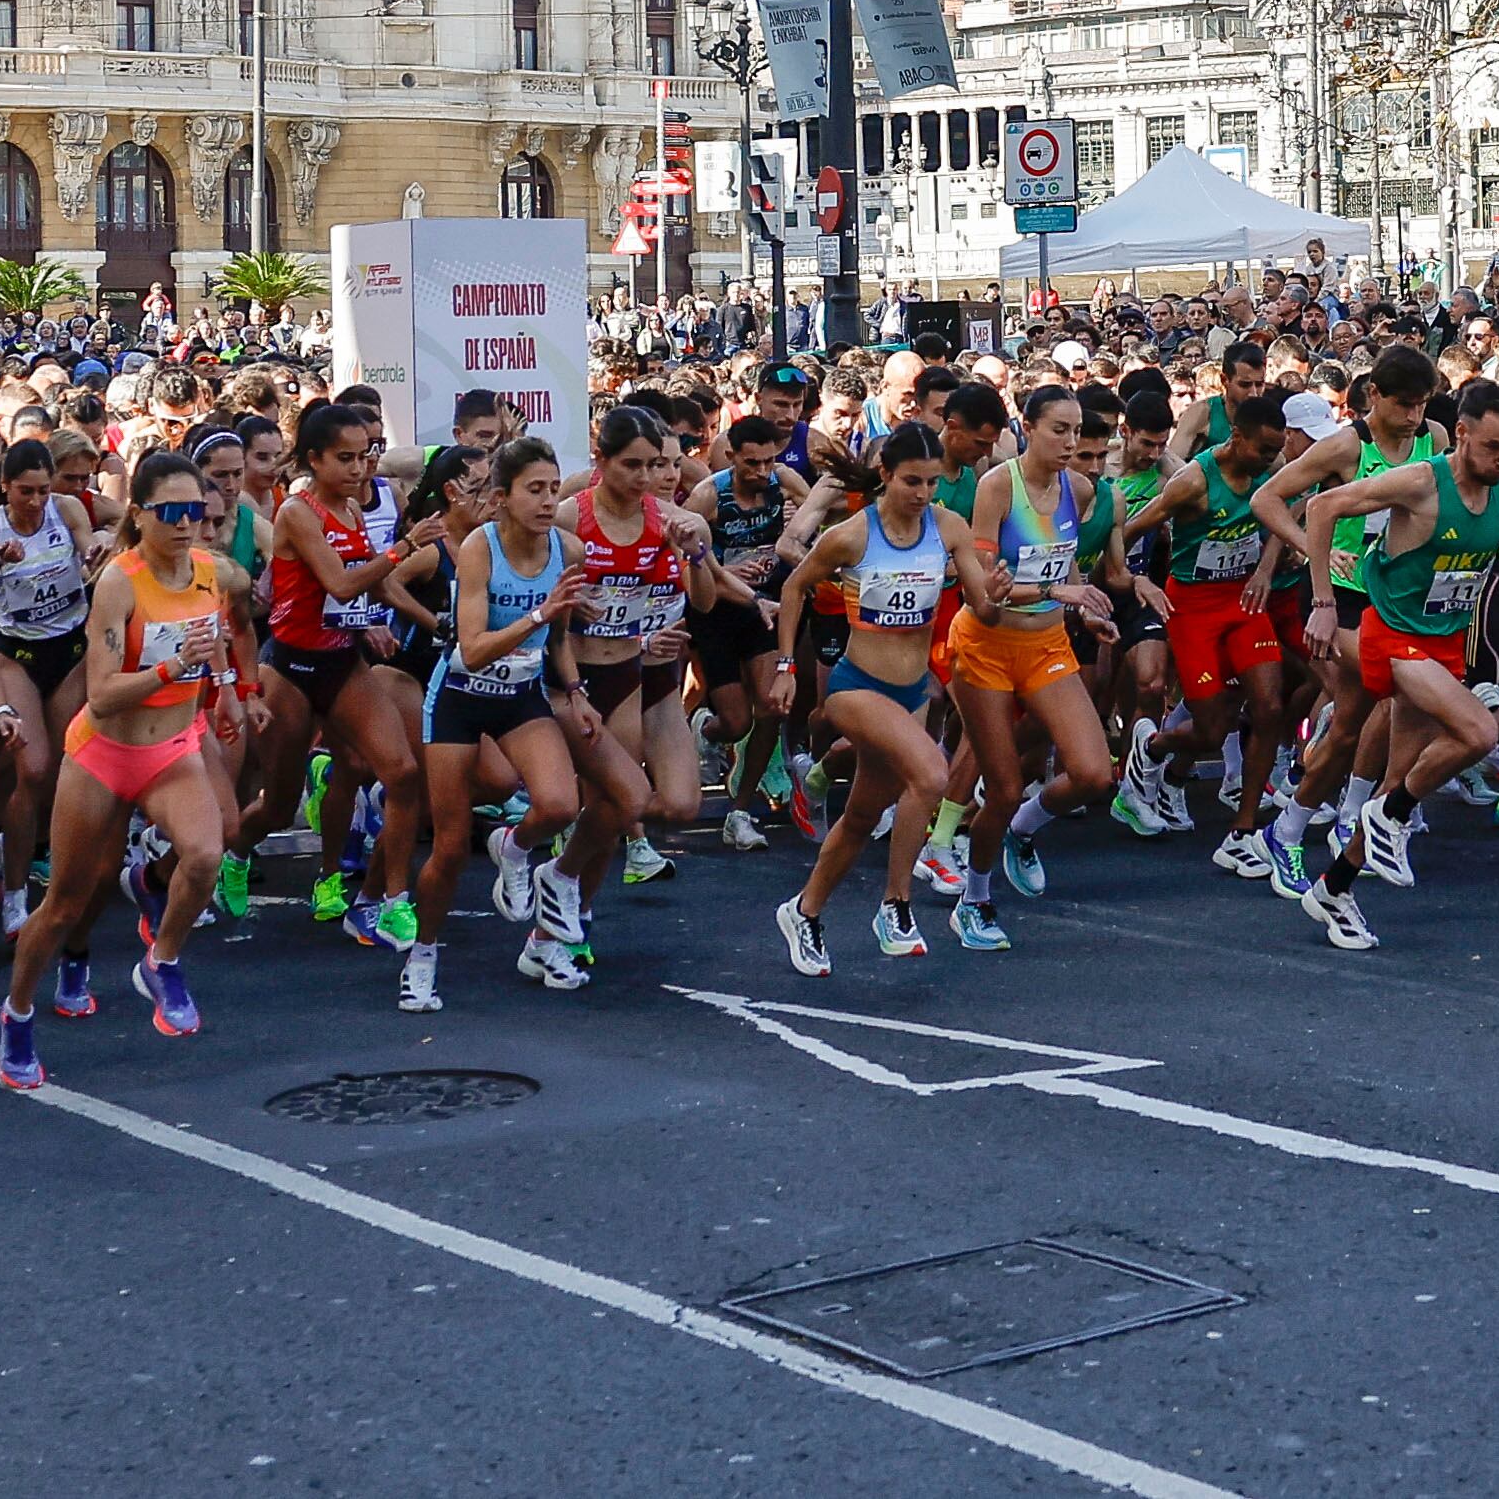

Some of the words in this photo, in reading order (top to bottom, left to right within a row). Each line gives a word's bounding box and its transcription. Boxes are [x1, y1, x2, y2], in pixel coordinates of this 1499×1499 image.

[771, 25, 808, 45] ENKHBAT
[899, 65, 935, 88] ABAO
[452, 283, 546, 318] CAMPEONATO
[465, 338, 480, 371] DE
[483, 331, 537, 371] ESPAÑA
[362, 362, 406, 383] Iberdrola
[1040, 560, 1064, 579] 47
[1216, 551, 1248, 569] 117
[617, 576, 641, 585] BM
[652, 584, 674, 596] BM
[33, 583, 59, 604] 44
[887, 590, 916, 611] 48
[1451, 584, 1481, 600] 11
[27, 597, 69, 621] Joma
[605, 605, 628, 623] 19
[642, 613, 666, 632] 22
[874, 612, 925, 626] Joma
[464, 676, 517, 695] Joma
